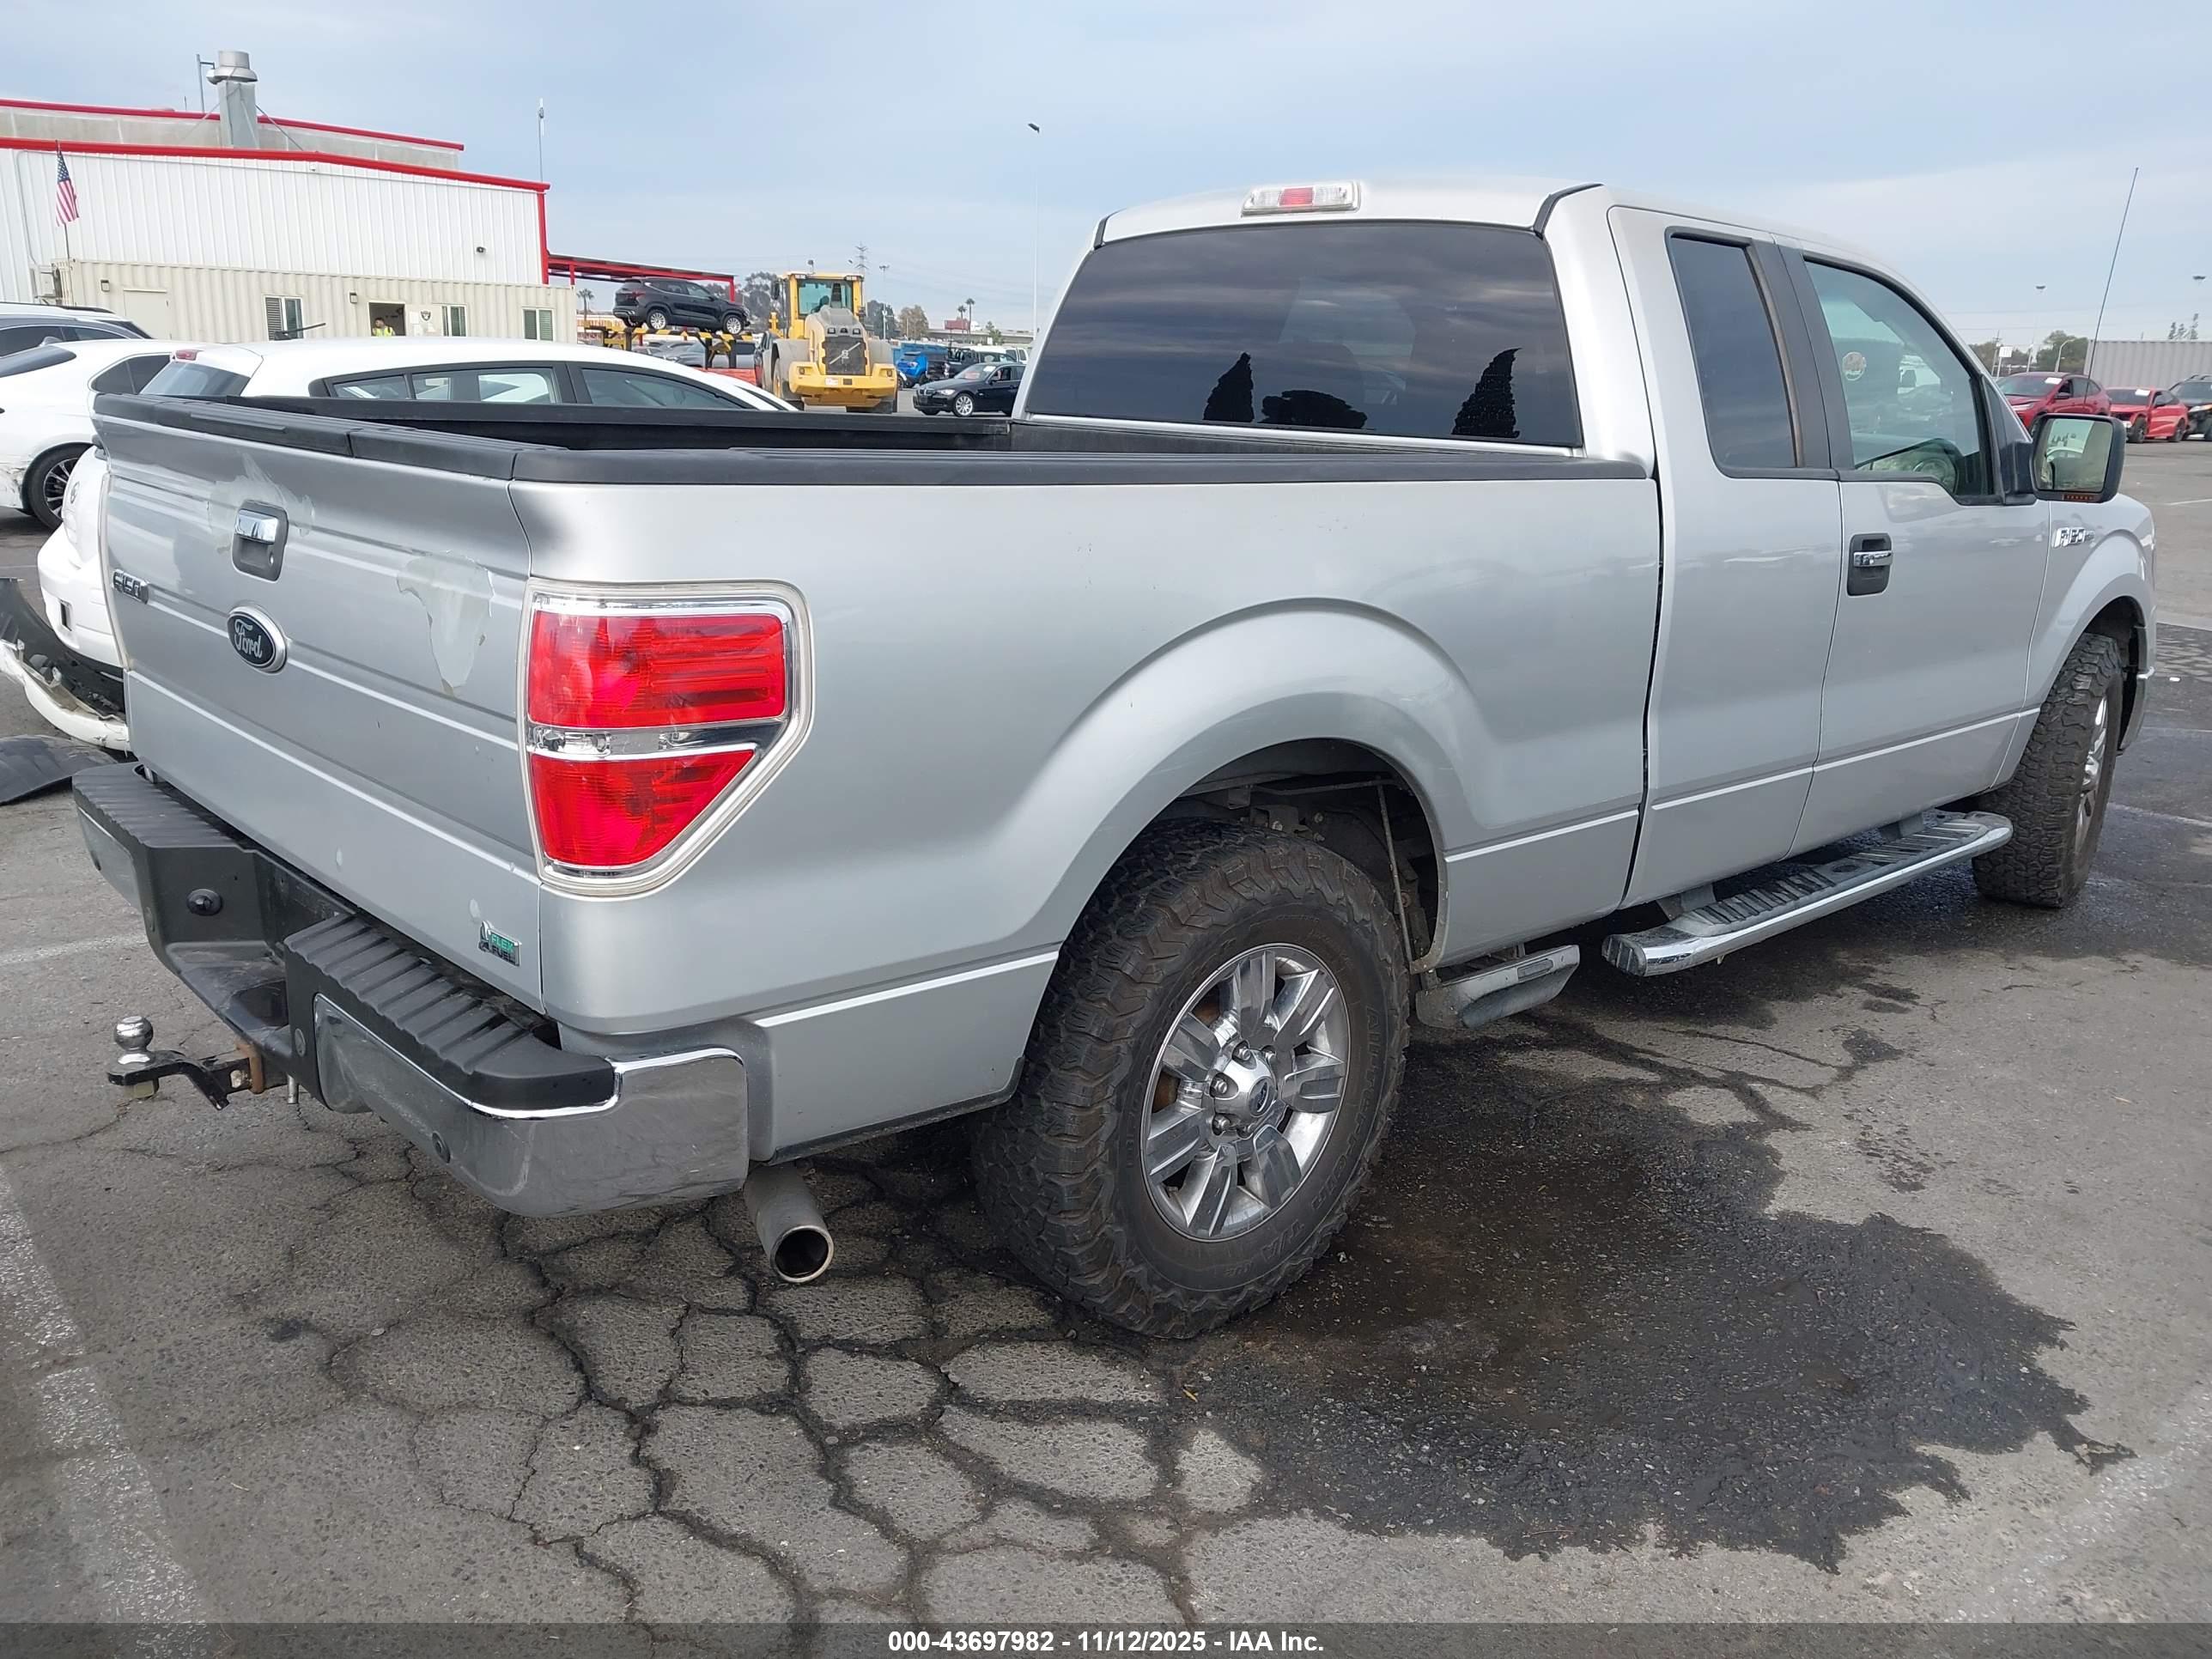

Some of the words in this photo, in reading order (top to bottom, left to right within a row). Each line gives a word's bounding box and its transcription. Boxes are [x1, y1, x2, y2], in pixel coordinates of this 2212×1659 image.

[234, 618, 263, 659] Ford
[491, 933, 514, 953] FLEX
[492, 945, 516, 964] FUEL
